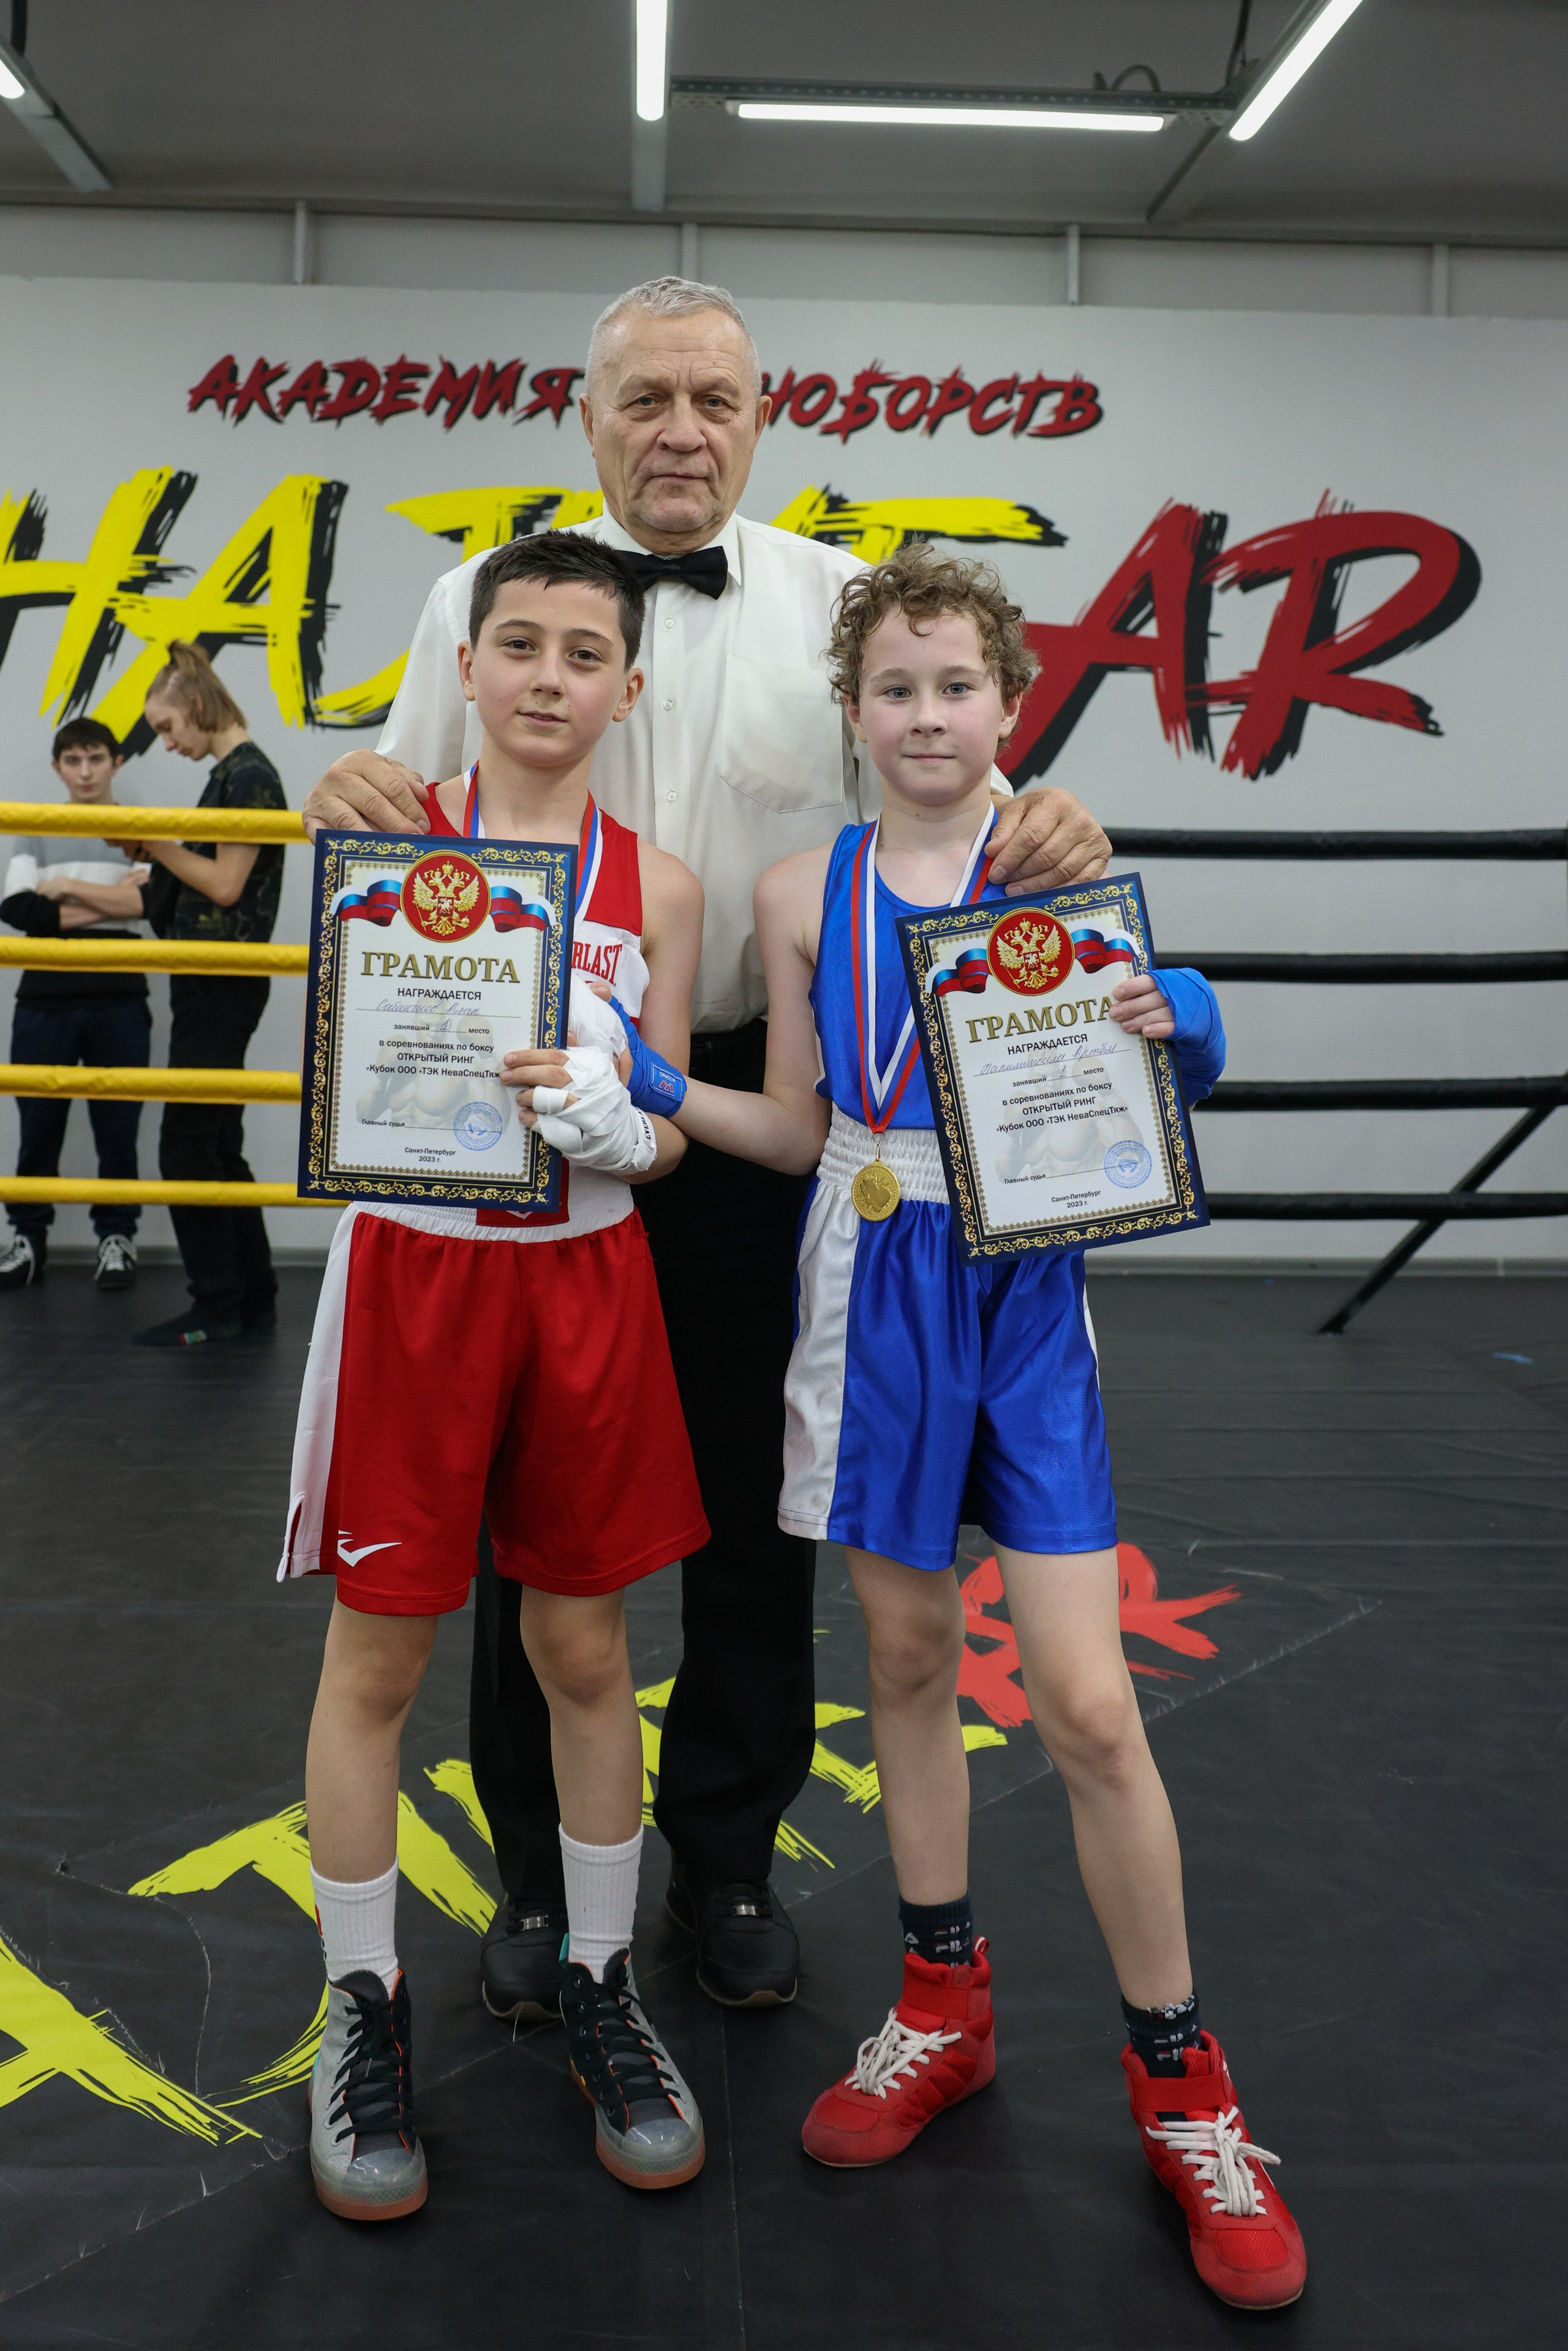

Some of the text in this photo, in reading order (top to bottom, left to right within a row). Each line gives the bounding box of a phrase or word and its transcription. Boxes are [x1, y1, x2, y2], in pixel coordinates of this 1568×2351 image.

[187, 353, 1104, 445] АКАДЕМИЯ НОБОРСТВ
[361, 951, 521, 983] ГРАМОТА
[571, 942, 622, 985] RLAST
[398, 987, 481, 1000] НАГРАЖДАЕТСЯ
[966, 996, 1114, 1043] ГРАМОТА
[386, 1040, 454, 1050] соревнованиях
[469, 1043, 494, 1053] боксу
[1008, 1033, 1088, 1055] НАГРАЖДАЕТСЯ
[397, 1052, 475, 1064] ОТКРЫТЫЙ РИНГ
[366, 1064, 395, 1074] «Кубок
[419, 1067, 439, 1076] «ТЭК
[1012, 1065, 1104, 1087] занявший 1 место
[1009, 1088, 1074, 1106] соревнованиях
[1088, 1082, 1112, 1092] боксу
[1022, 1096, 1096, 1115] ОТКРЫТЫЙ РИНГ
[996, 1106, 1128, 1133] «Кубок ООО «ТЭК НеваСпецТяж»
[405, 1147, 456, 1157] Санкт-Петербург
[1005, 1175, 1029, 1184] Главный
[1051, 1190, 1101, 1202] Санкт-Петербург
